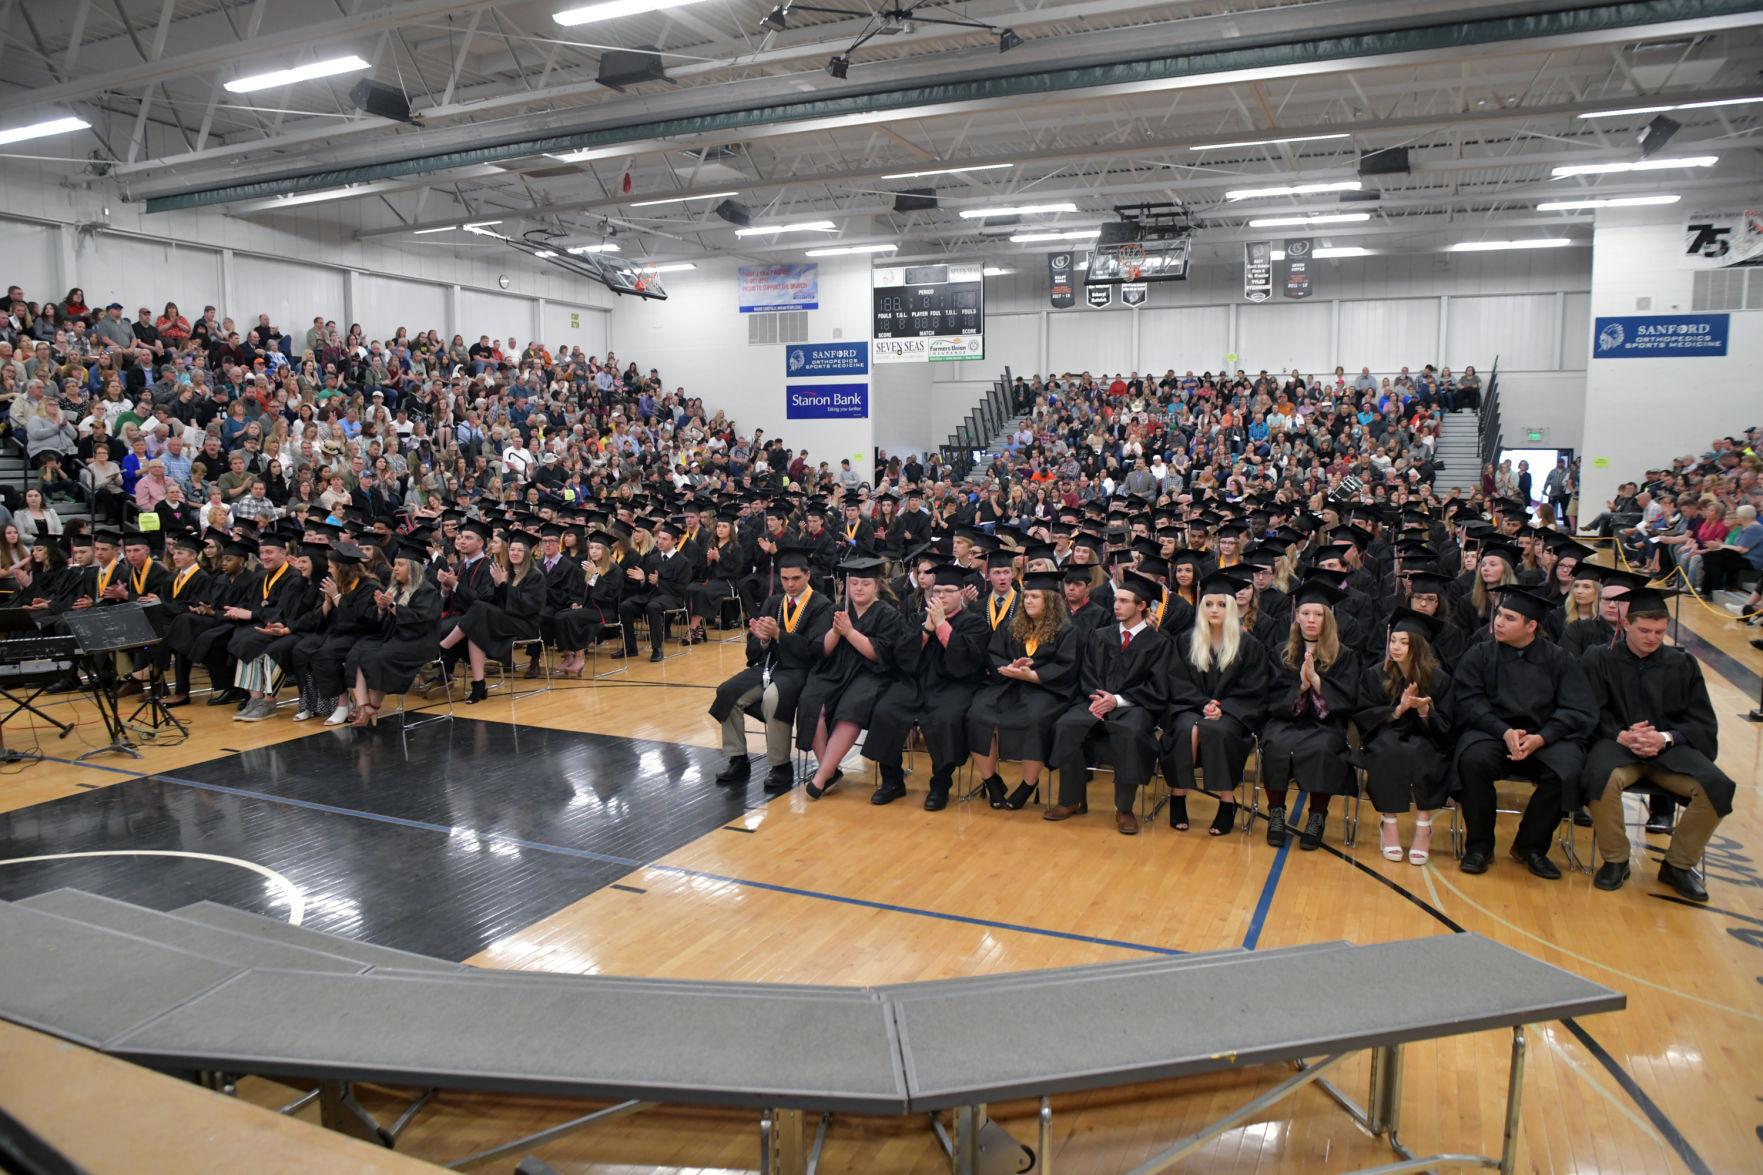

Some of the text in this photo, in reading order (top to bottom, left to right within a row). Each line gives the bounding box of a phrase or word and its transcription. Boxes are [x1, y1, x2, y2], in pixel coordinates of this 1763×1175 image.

[1686, 224, 1732, 258] 75
[1637, 323, 1711, 335] SANFORD
[1625, 340, 1722, 349] SPORTS MEDICINE
[1635, 335, 1712, 343] ORTHOPEDICS
[876, 340, 925, 353] SEVEN SEAS
[812, 349, 857, 359] SANFORD
[792, 392, 862, 406] Starion Bank
